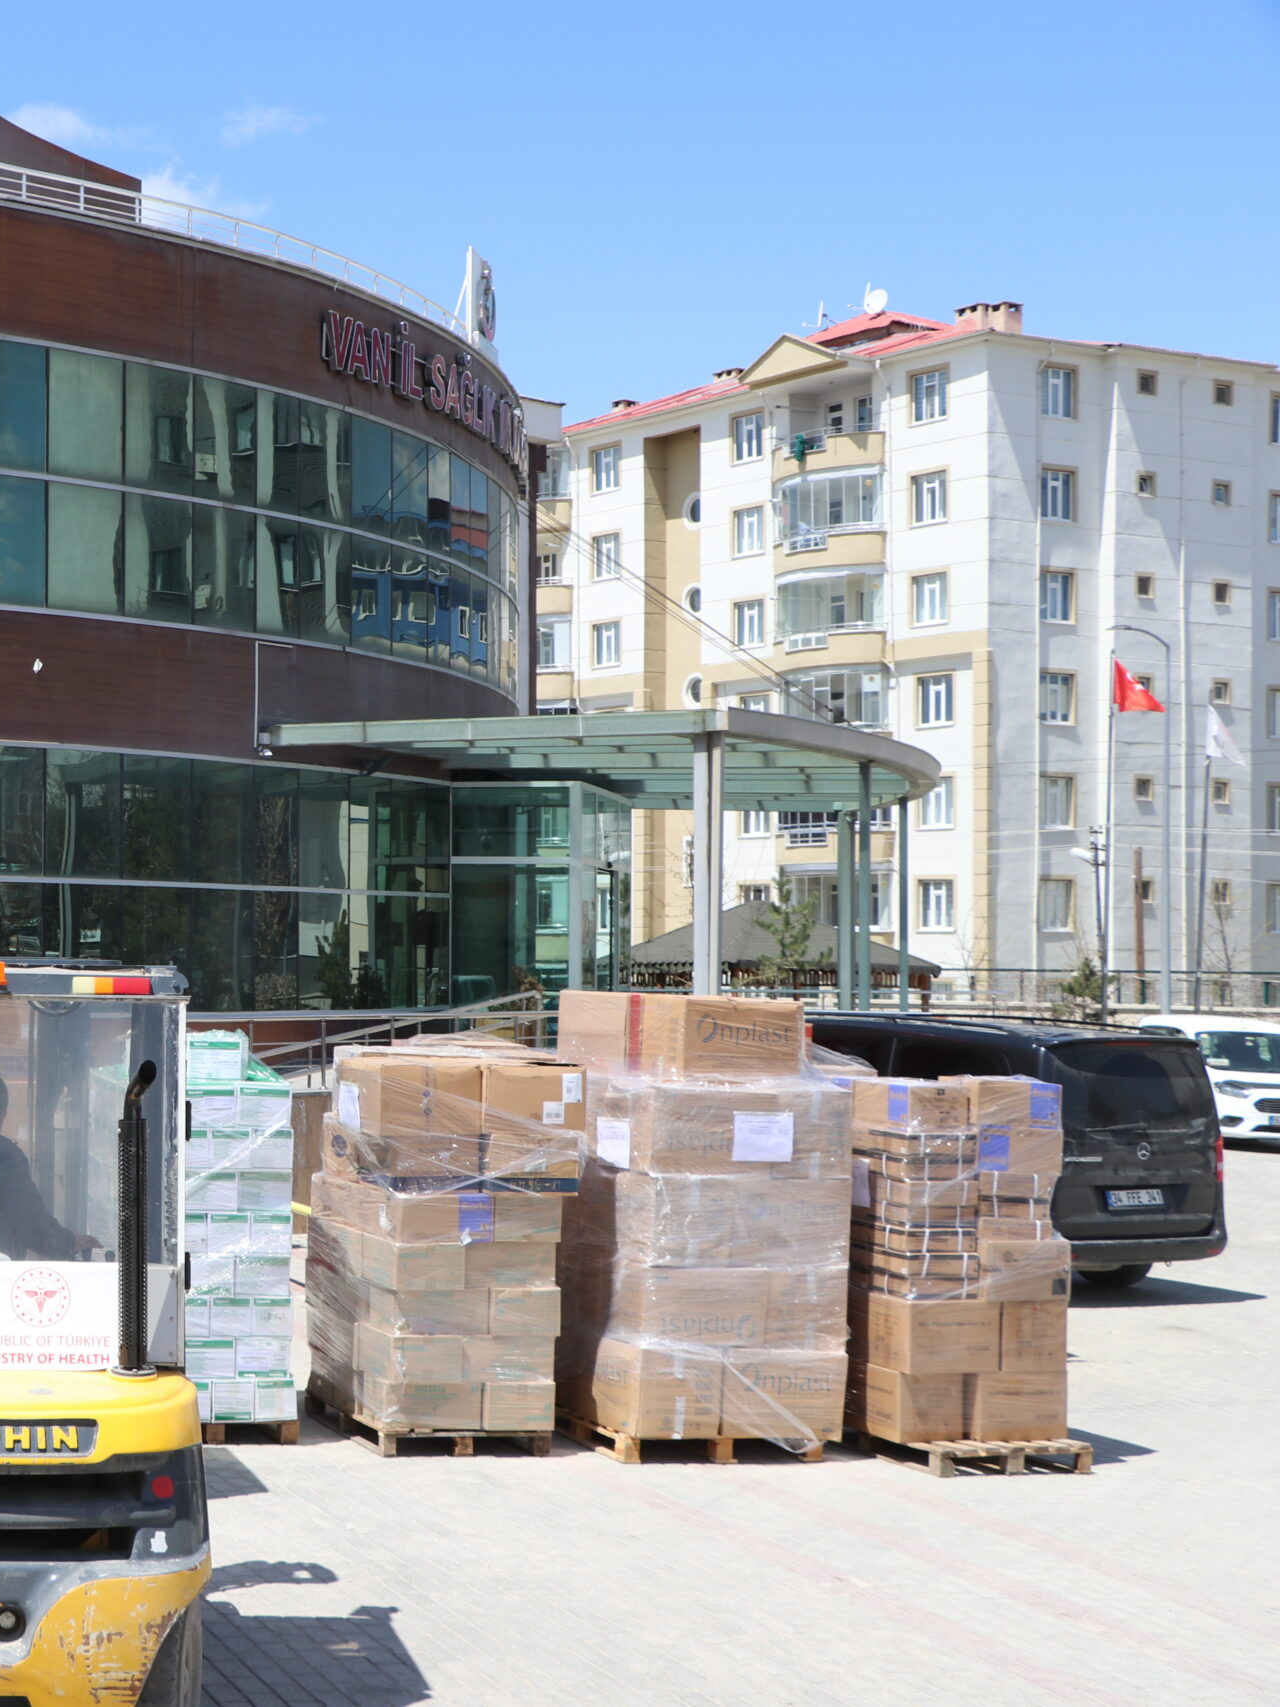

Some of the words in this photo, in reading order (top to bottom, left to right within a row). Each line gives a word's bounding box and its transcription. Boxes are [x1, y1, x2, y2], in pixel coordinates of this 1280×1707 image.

[328, 310, 392, 388] VAN
[398, 321, 423, 400] İL
[430, 351, 497, 444] SAĞLIK
[696, 1012, 792, 1046] Onplast
[36, 1335, 53, 1347] OF
[56, 1333, 111, 1348] TÜRKİYE
[37, 1353, 55, 1364] OF
[58, 1353, 110, 1365] HEALTH
